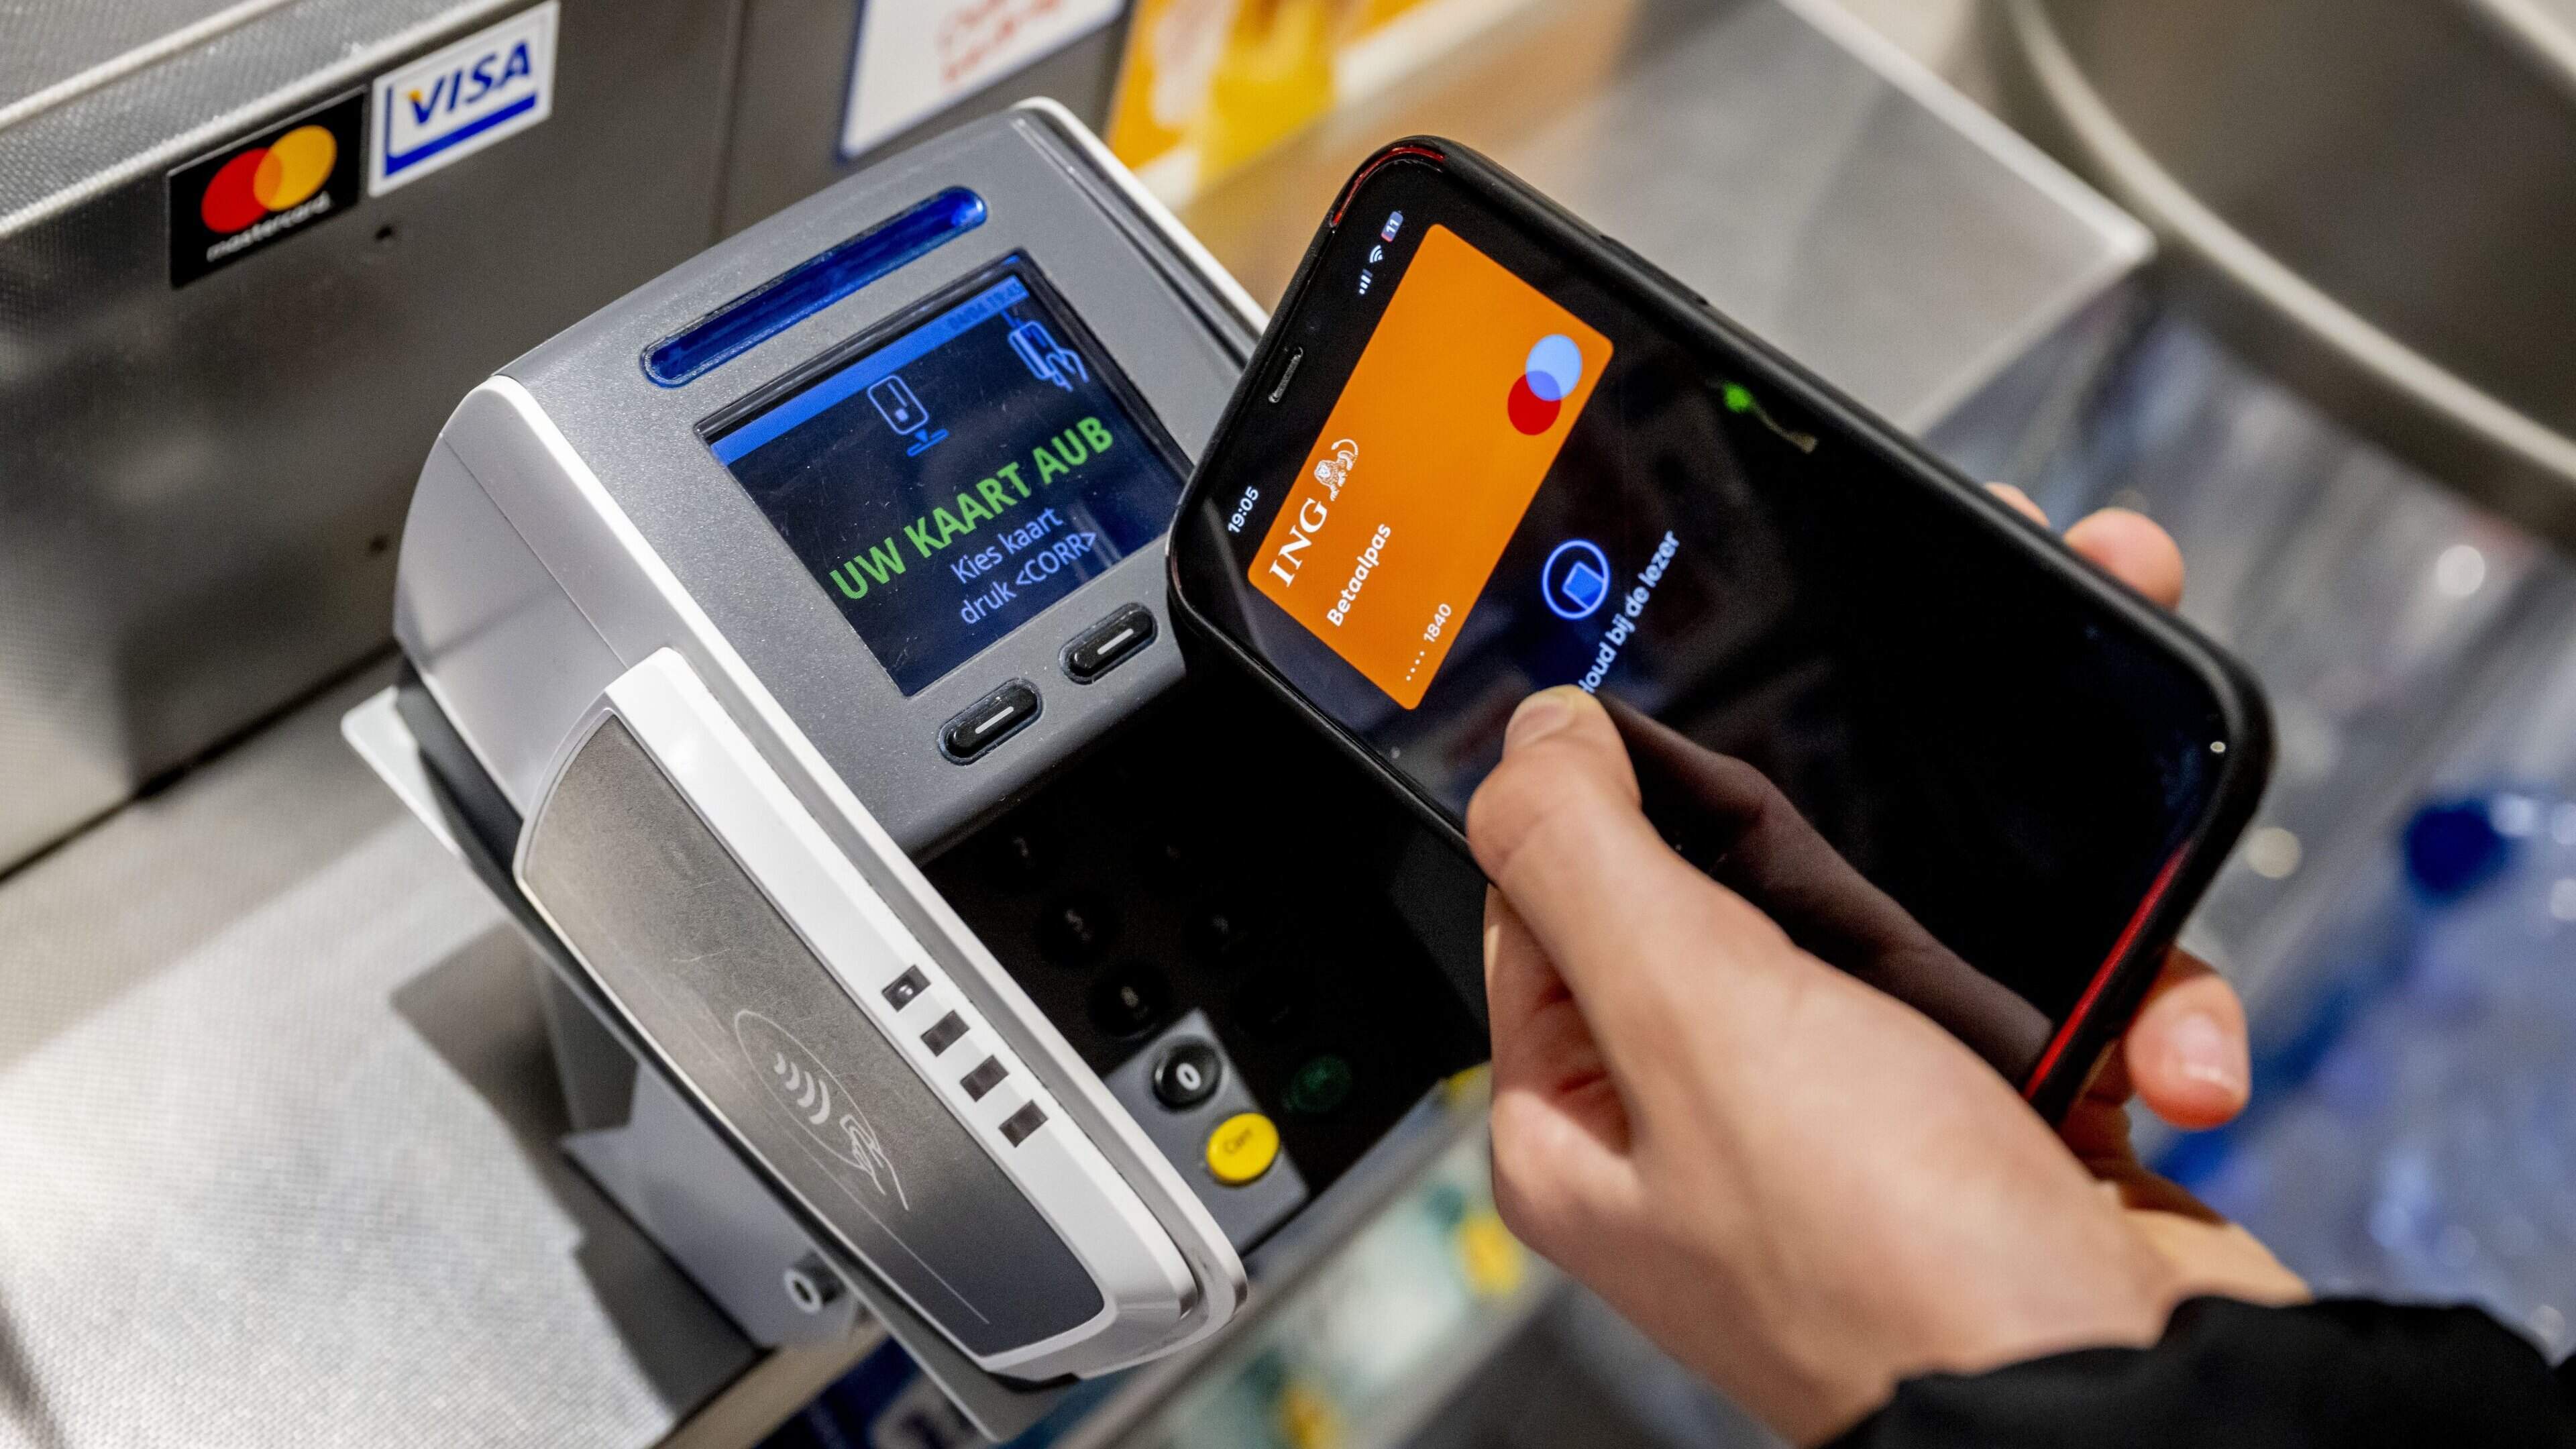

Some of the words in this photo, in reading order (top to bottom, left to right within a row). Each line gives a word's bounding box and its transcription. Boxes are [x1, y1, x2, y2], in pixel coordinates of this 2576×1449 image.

[408, 40, 530, 125] VISA
[1386, 219, 1399, 233] 11
[829, 537, 906, 600] UW
[904, 462, 1032, 558] KAART
[1032, 417, 1114, 485] AUB
[951, 546, 1003, 584] Kies
[998, 507, 1064, 555] kaart
[1228, 486, 1259, 533] 19:05
[1269, 497, 1328, 588] ING
[961, 581, 1017, 625] druk
[1016, 531, 1097, 586] <CORR>
[1326, 523, 1392, 627] Betaalpas
[1605, 613, 1635, 646] bij
[1625, 586, 1650, 617] de
[1638, 530, 1680, 588] lezer
[1423, 603, 1452, 643] 1840
[1176, 1063, 1201, 1091] 0
